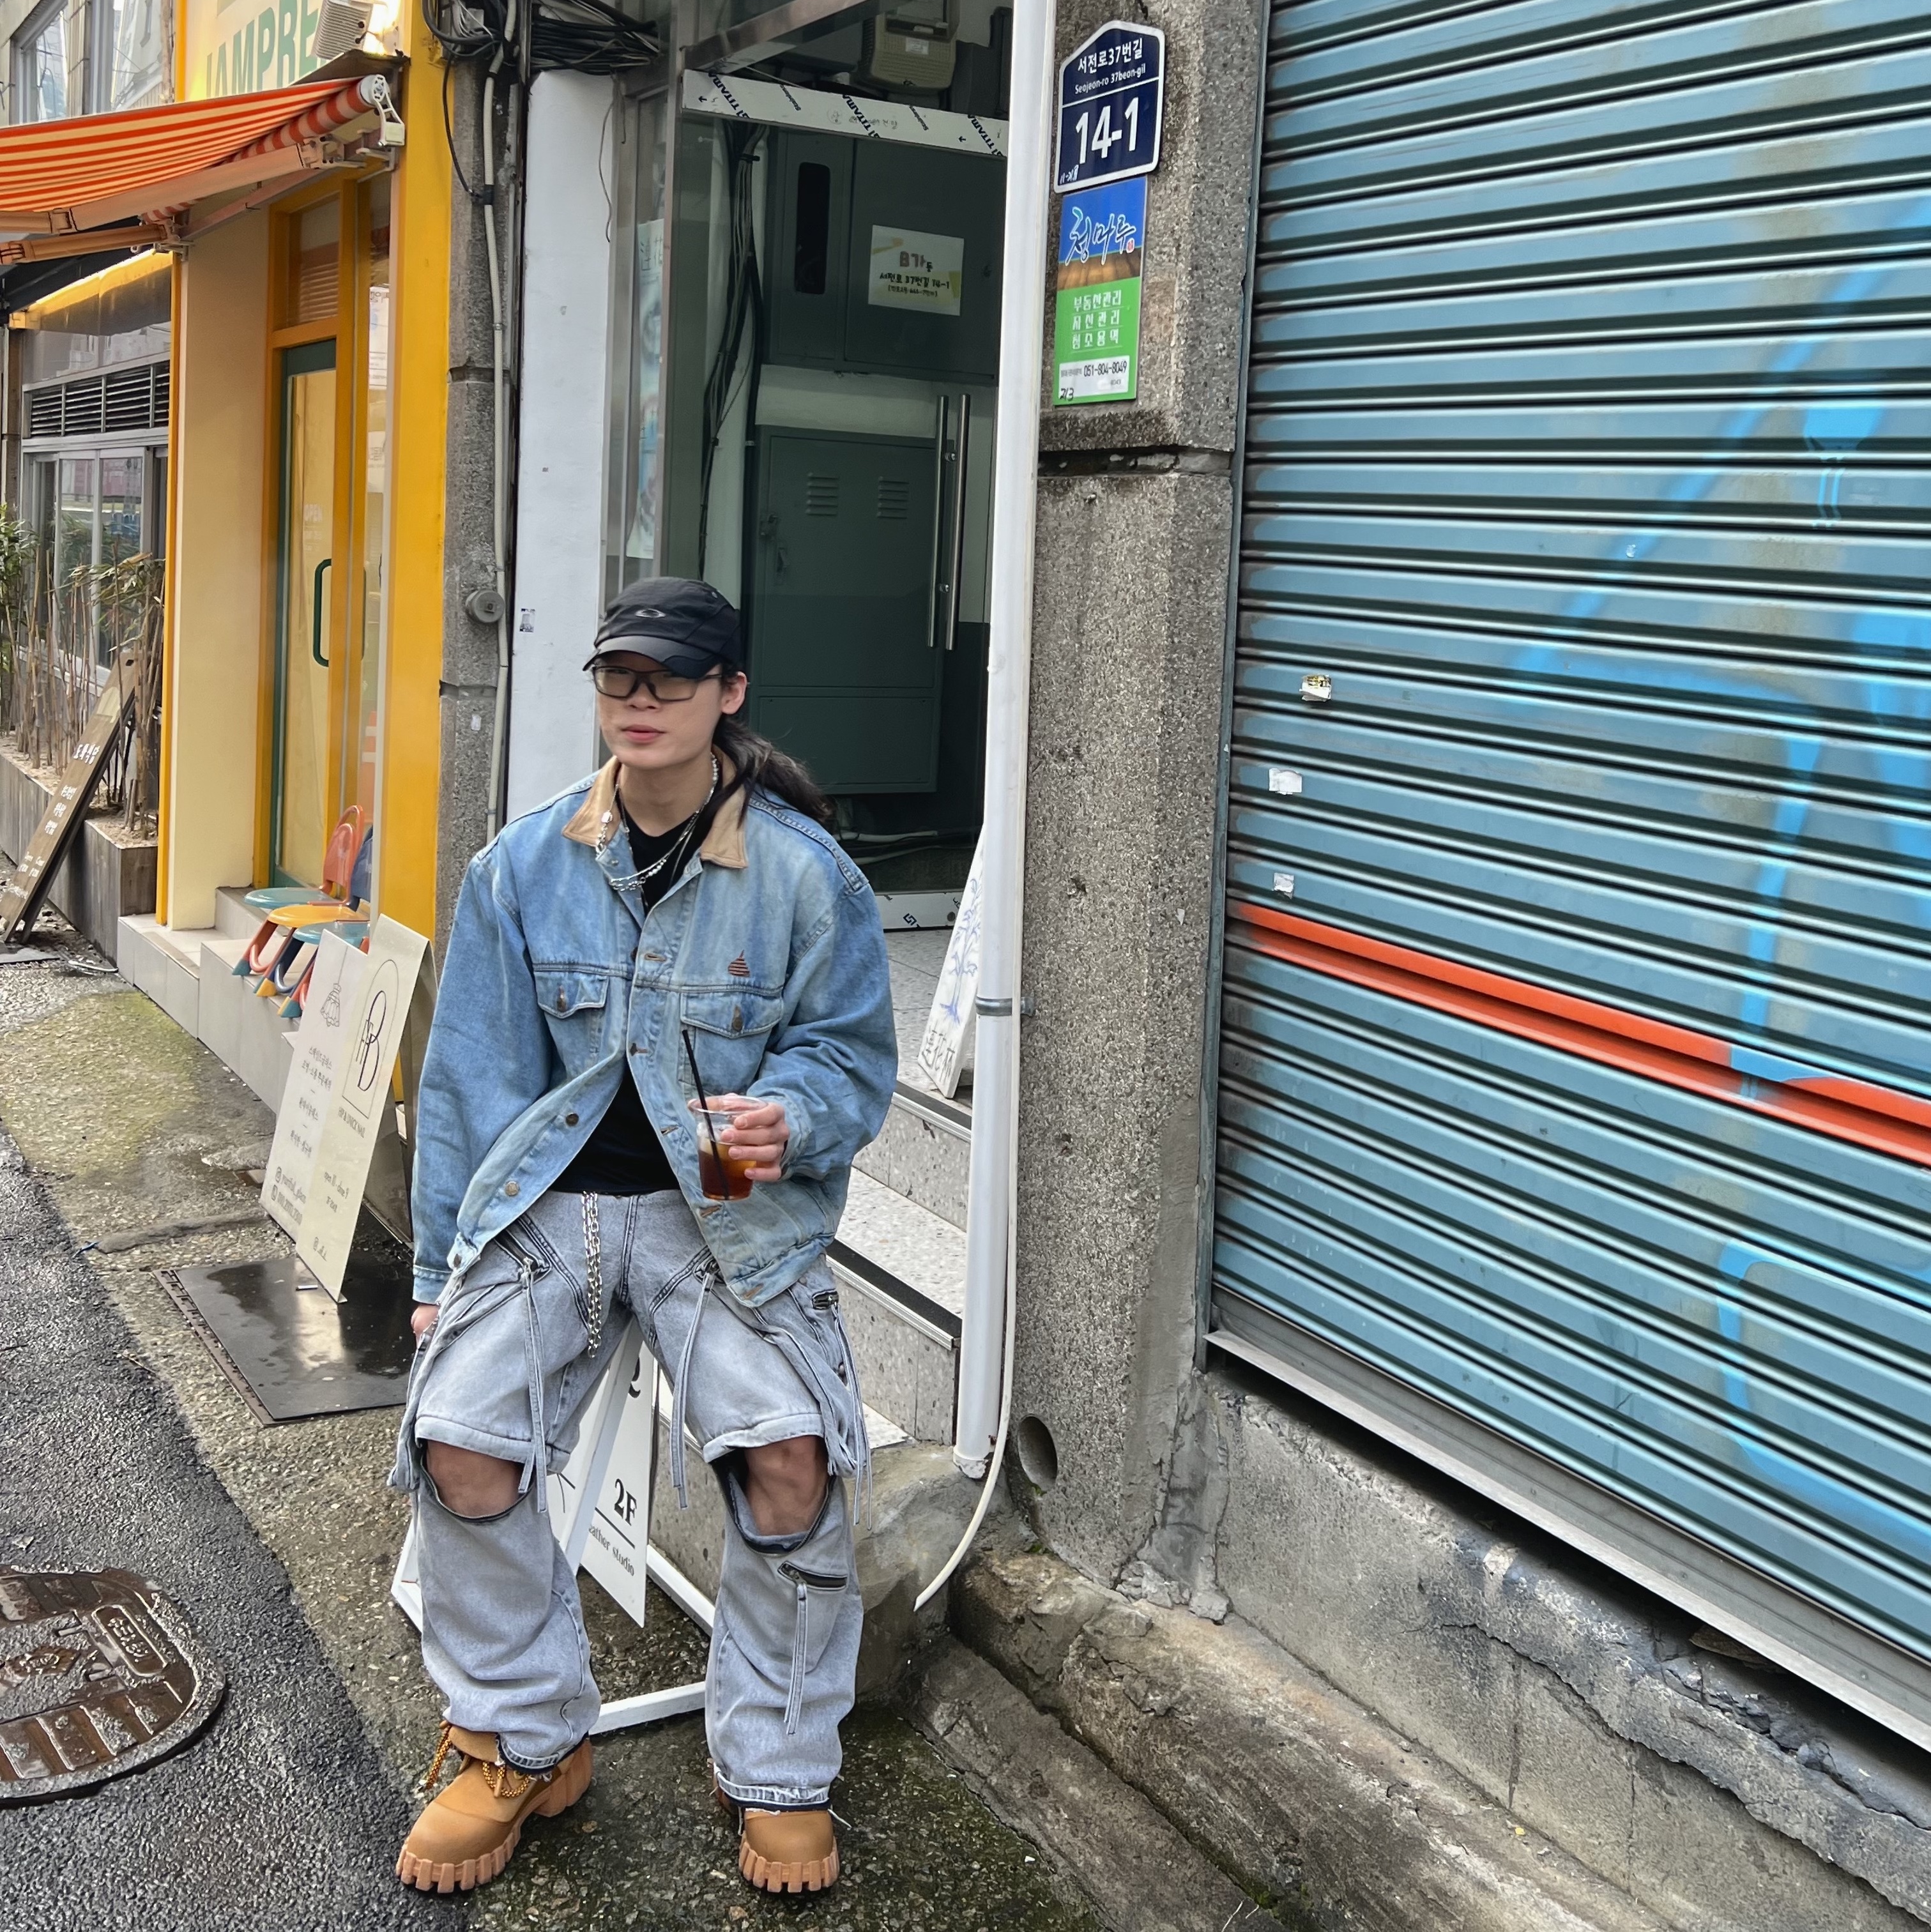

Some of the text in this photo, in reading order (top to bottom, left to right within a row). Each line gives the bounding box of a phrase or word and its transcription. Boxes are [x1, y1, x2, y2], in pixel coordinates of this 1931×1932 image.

[1078, 38, 1142, 73] 서전로37번길
[1075, 63, 1145, 94] Seojeon-ro 37beon-gil
[1076, 97, 1138, 164] 14-1
[1074, 290, 1122, 312] 부동산관리
[1083, 360, 1127, 377] 051-804-8049
[614, 1478, 637, 1526] 2F
[613, 1546, 635, 1577] studio
